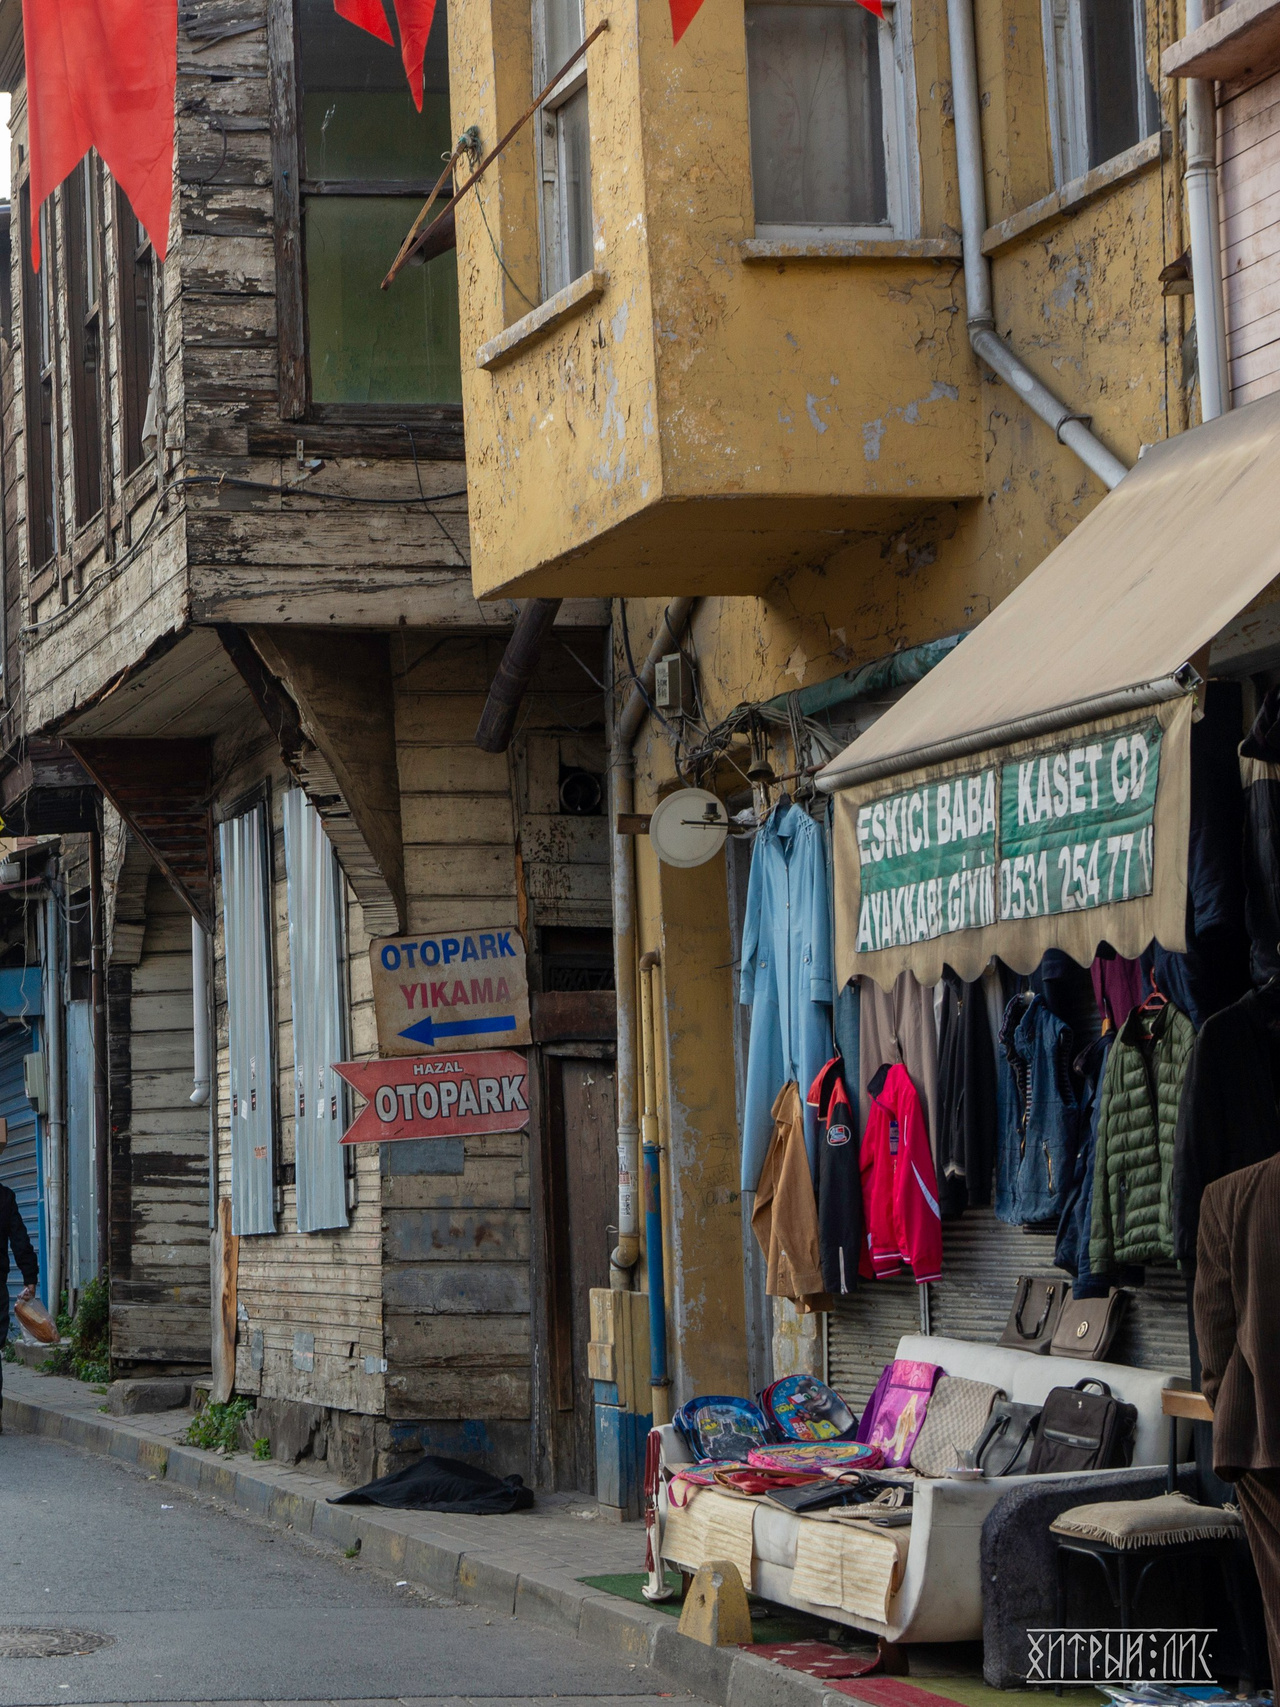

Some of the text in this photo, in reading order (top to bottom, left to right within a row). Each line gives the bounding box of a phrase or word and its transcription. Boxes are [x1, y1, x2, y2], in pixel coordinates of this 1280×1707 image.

[937, 770, 996, 846] BABA
[1018, 743, 1103, 826] KASET
[1111, 732, 1149, 804] CD
[856, 877, 943, 952] AYAKKABI
[999, 850, 1049, 919] 0531
[1058, 839, 1100, 909] 254
[1107, 833, 1134, 901] 77
[381, 931, 517, 971] OTOPARK
[400, 977, 511, 1010] YIKAMA
[413, 1061, 463, 1076] HAZAL
[375, 1073, 529, 1123] OTOPARK
[774, 1403, 796, 1415] TOM
